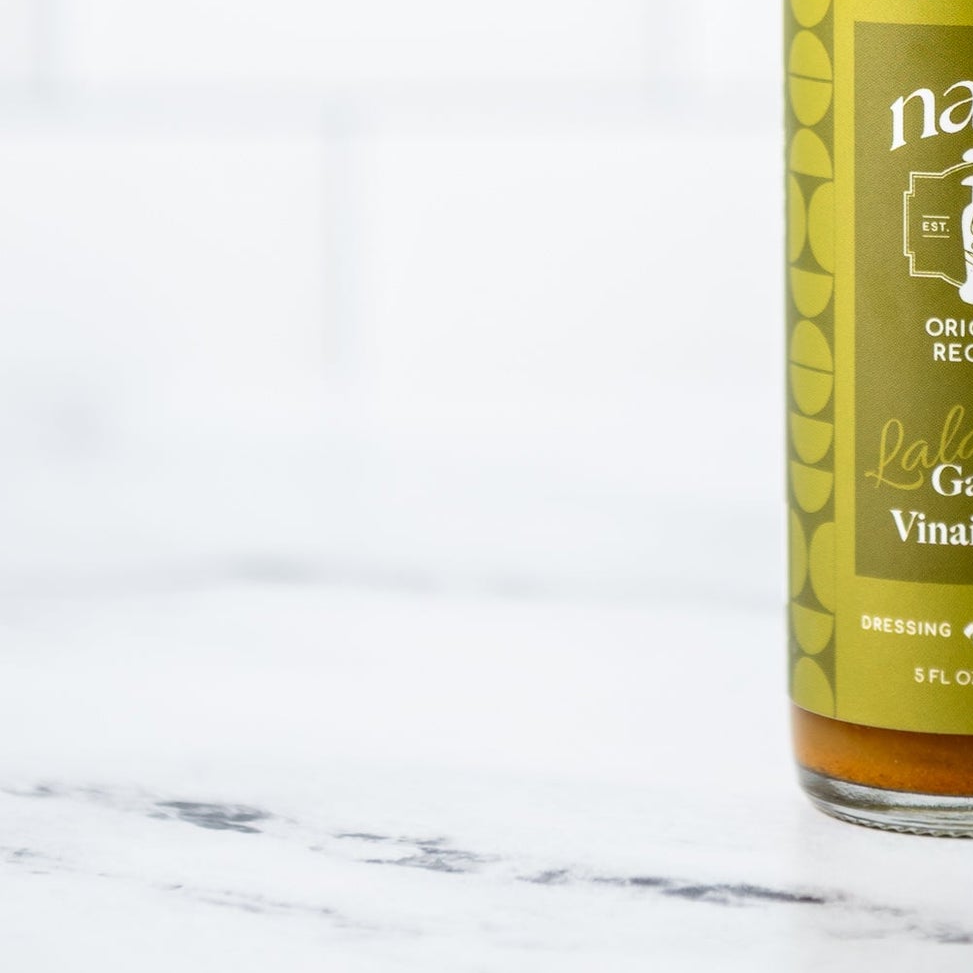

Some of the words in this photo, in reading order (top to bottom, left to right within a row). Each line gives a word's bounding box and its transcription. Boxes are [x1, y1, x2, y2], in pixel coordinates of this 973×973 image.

[922, 221, 950, 233] EST.
[861, 615, 952, 638] DRESSING
[914, 667, 924, 683] 5
[928, 669, 950, 685] FL
